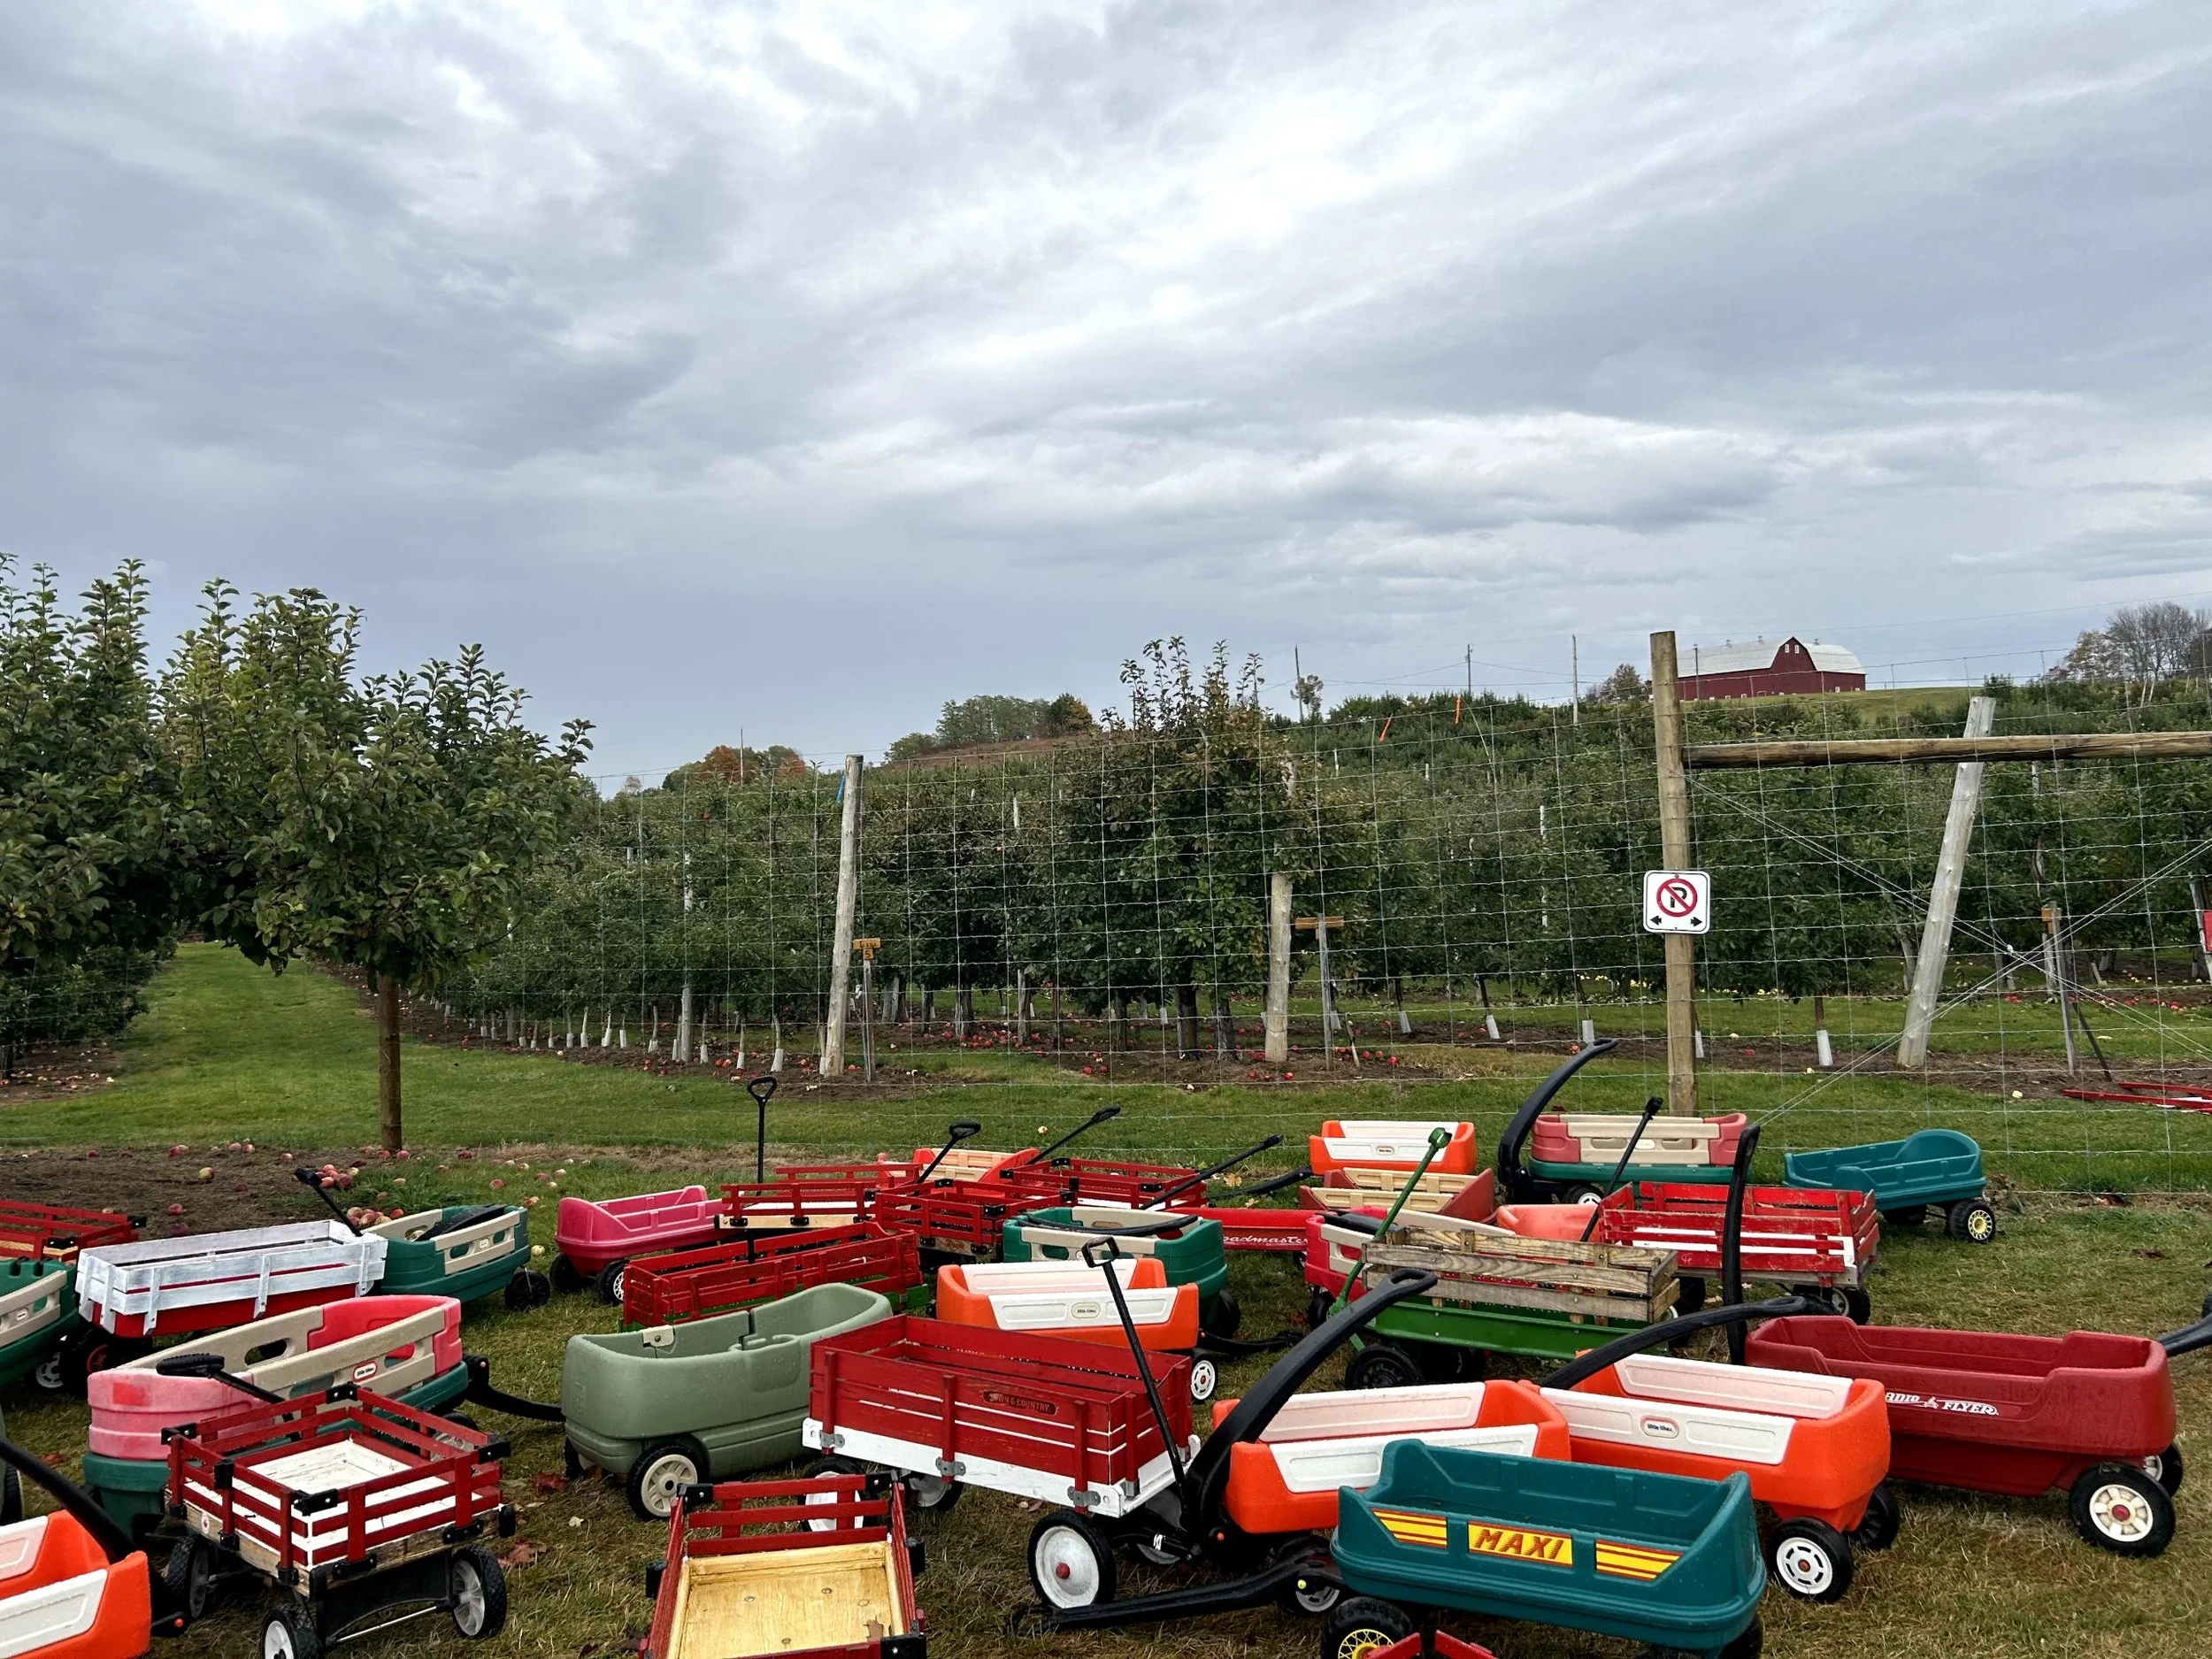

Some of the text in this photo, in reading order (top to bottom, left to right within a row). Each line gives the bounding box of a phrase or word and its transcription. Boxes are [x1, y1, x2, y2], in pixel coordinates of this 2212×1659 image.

[1671, 887, 1687, 908] P
[1223, 1235, 1309, 1244] oadmaster
[989, 1393, 1009, 1402] WN
[1017, 1399, 1049, 1411] COUNTRY
[1885, 1392, 1998, 1416] ADIO FLYER
[1473, 1529, 1564, 1560] MAXI
